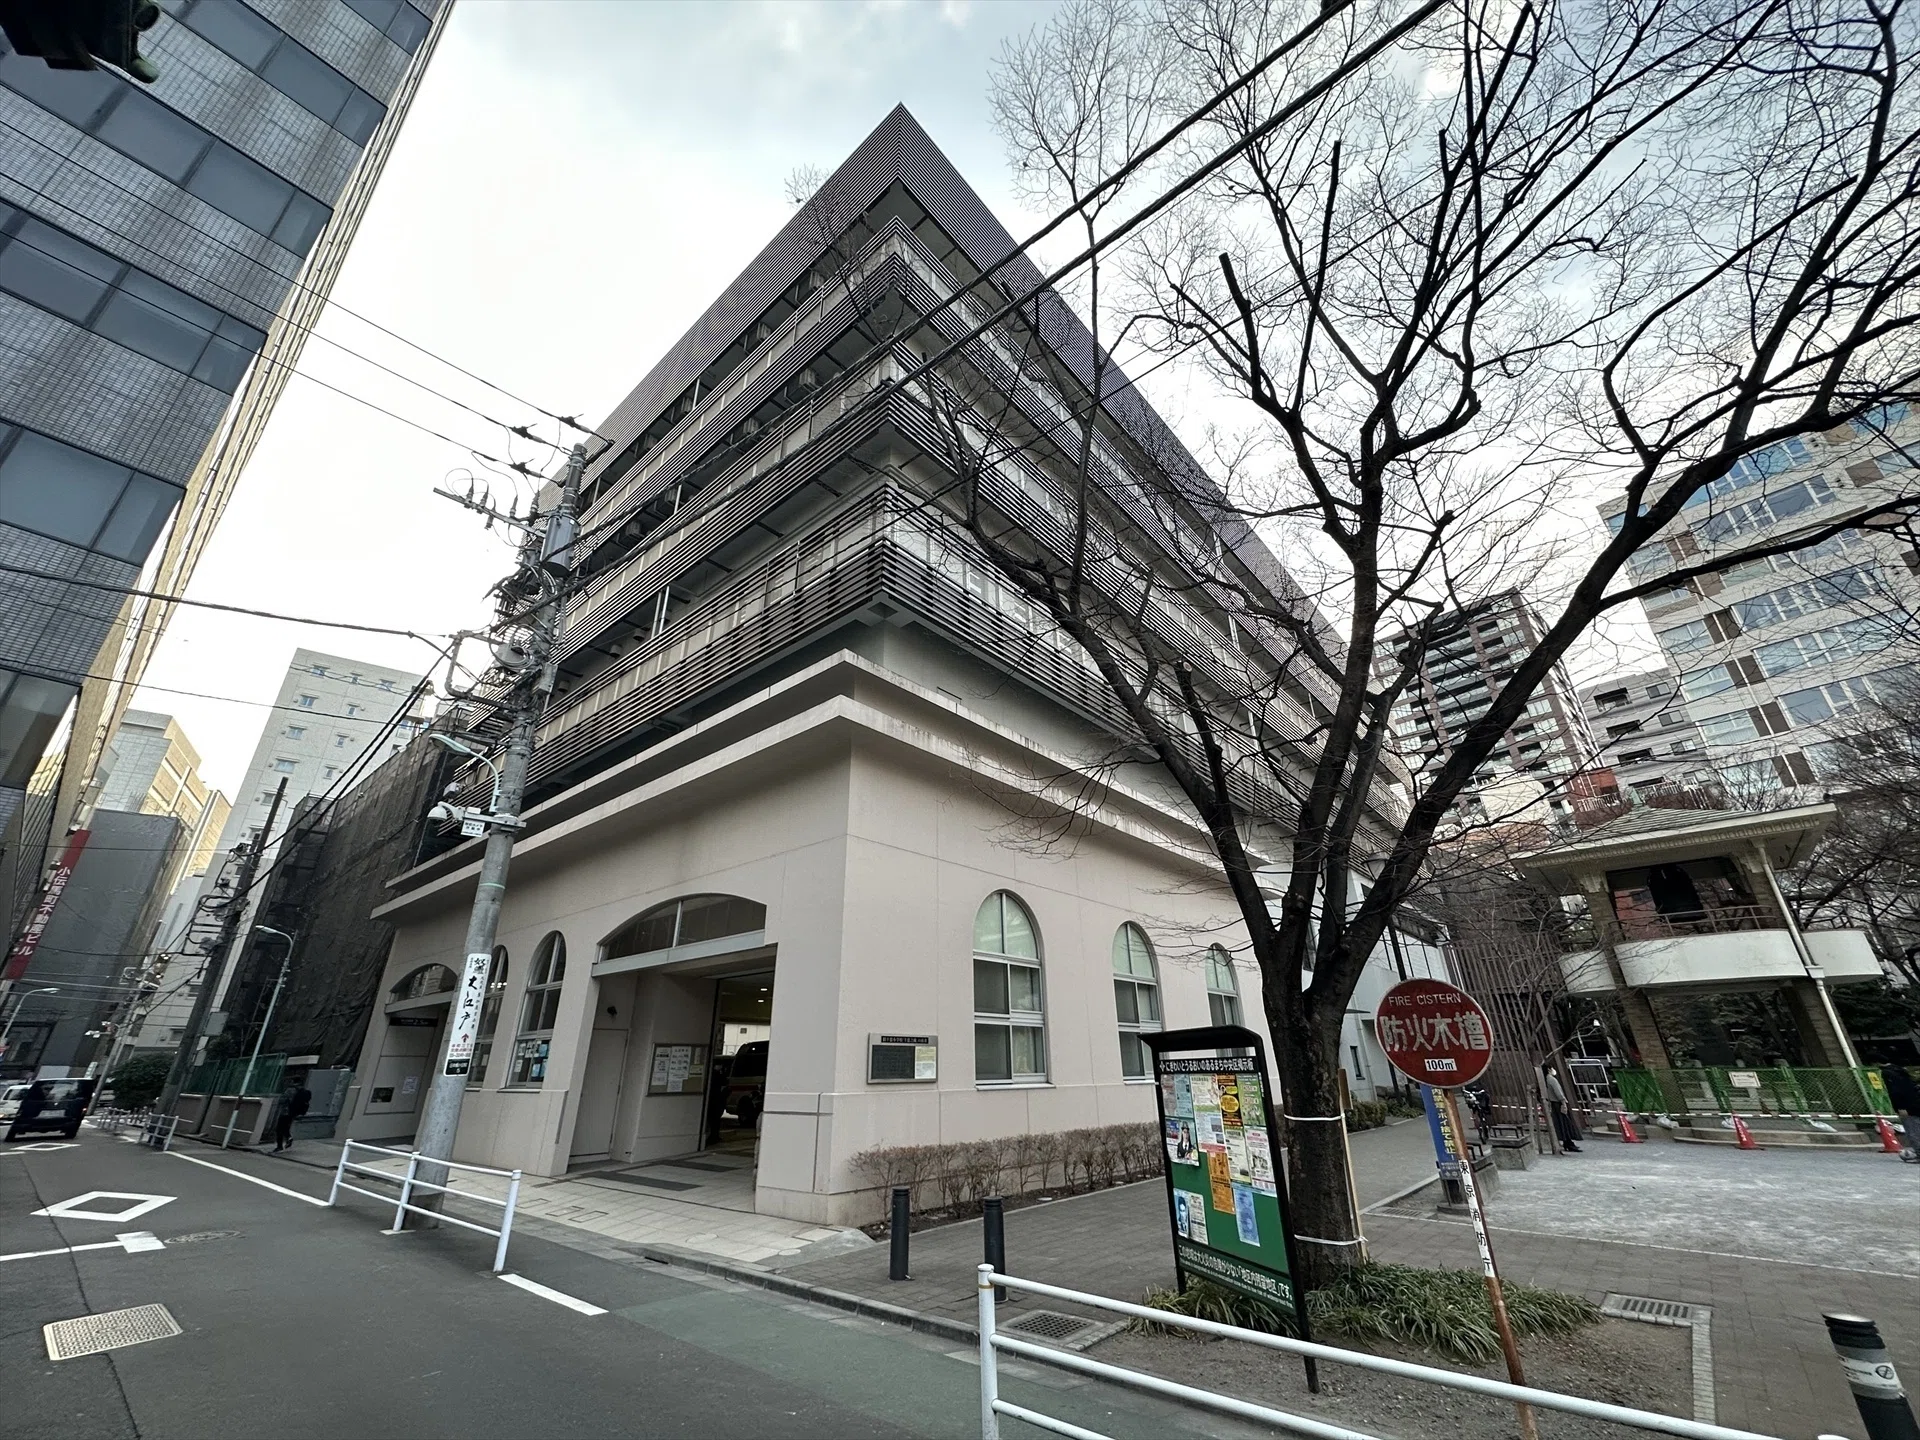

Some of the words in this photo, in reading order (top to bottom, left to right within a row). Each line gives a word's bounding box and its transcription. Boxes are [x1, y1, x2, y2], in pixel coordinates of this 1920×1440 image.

[18, 866, 71, 956] 小伝馬町不動産ビル
[1388, 995, 1412, 1007] FIRE
[1416, 993, 1461, 1005] CISTERN
[1165, 1057, 1255, 1073] にぎわいとうるおいのあるまち中央区掲示板
[1460, 1161, 1490, 1271] 東京消防庁
